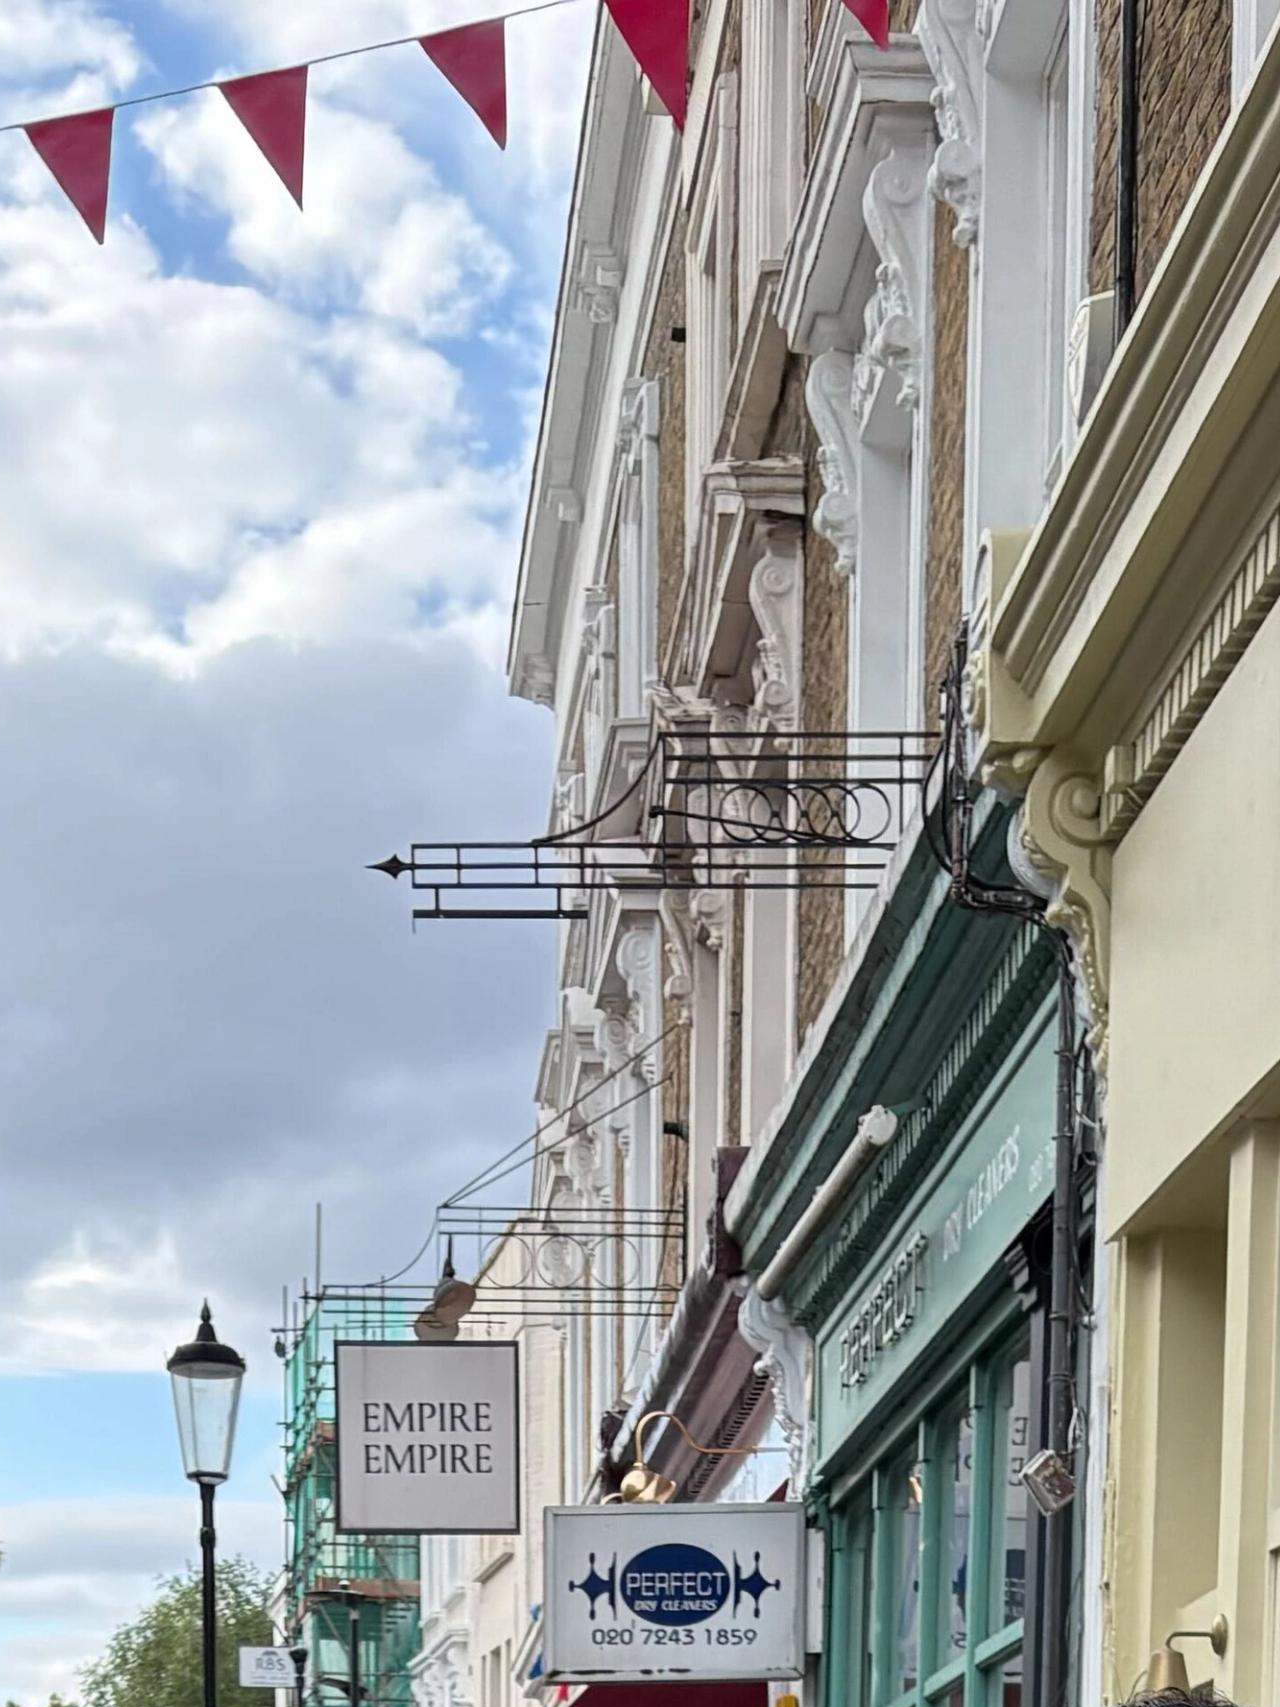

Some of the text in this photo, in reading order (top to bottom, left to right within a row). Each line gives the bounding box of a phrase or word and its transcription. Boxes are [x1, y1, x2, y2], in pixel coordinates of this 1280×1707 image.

[363, 1402, 492, 1433] EMPIRE
[364, 1444, 493, 1474] EMPIRE
[626, 1572, 726, 1596] PERFECT
[634, 1600, 719, 1612] DRY CLEANERS
[592, 1628, 758, 1646] 020 7243 1859
